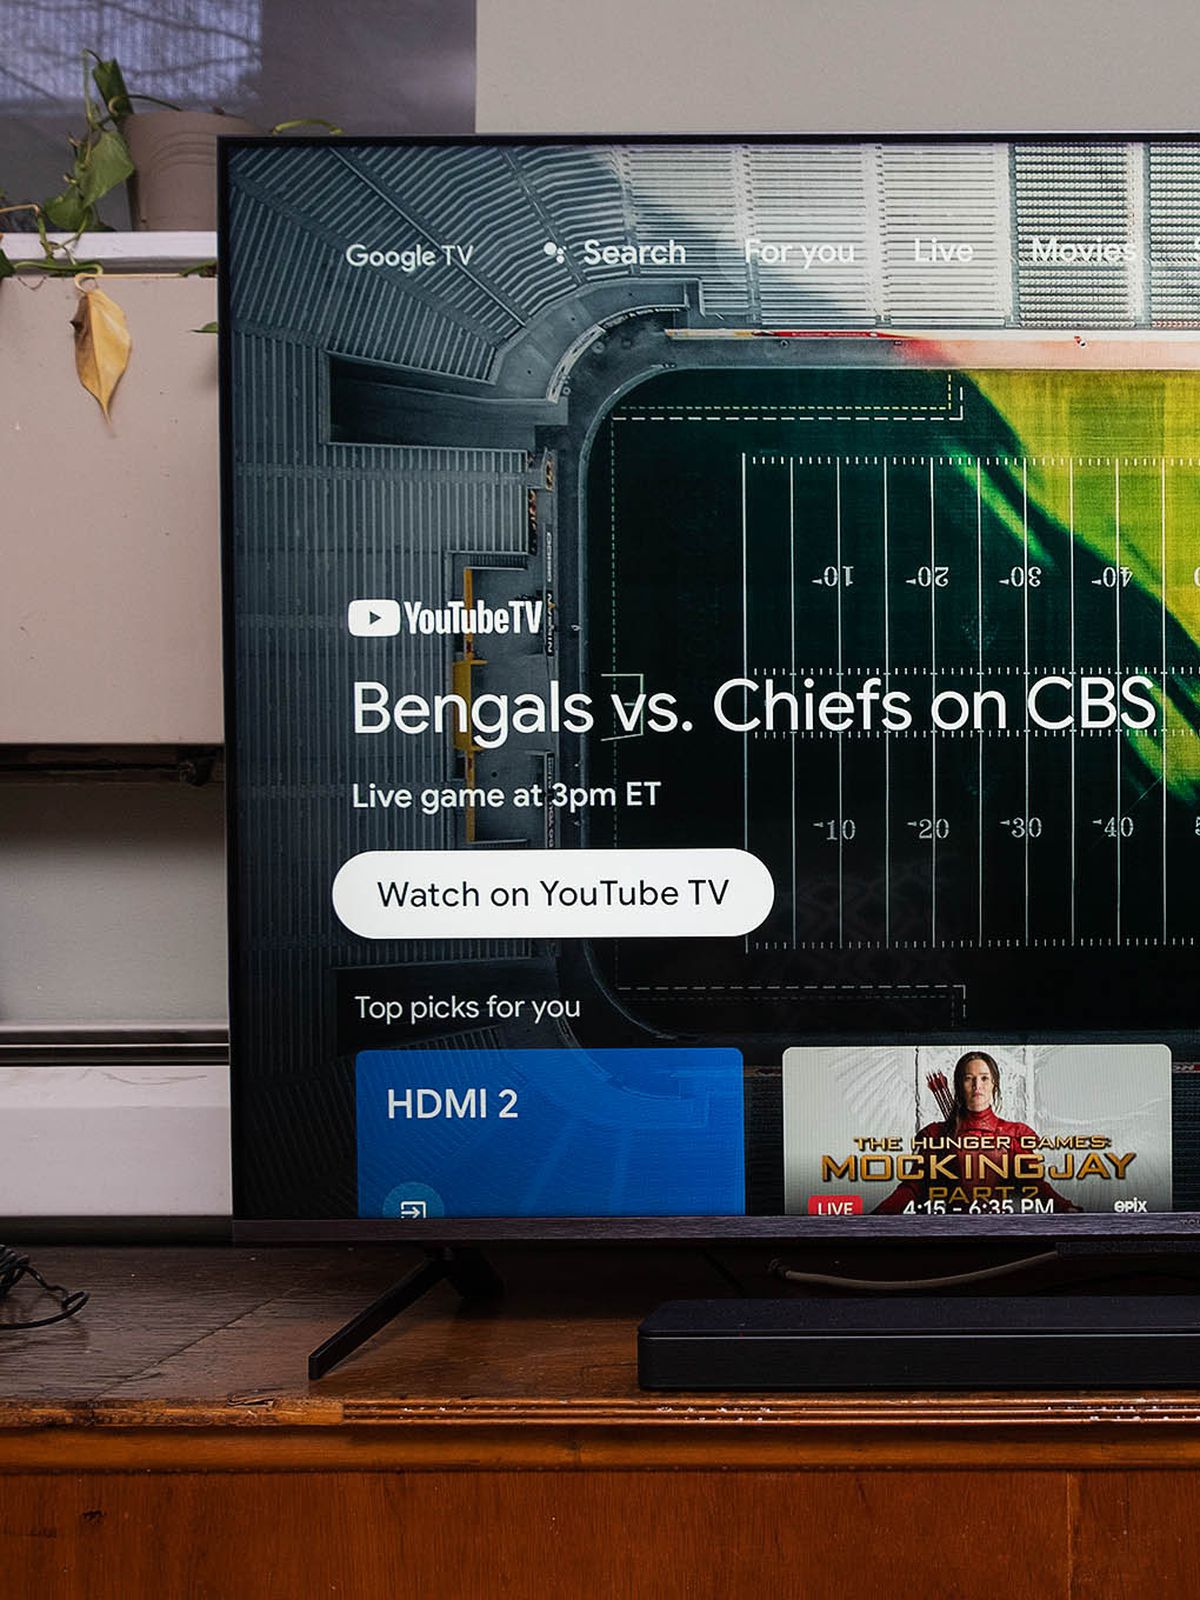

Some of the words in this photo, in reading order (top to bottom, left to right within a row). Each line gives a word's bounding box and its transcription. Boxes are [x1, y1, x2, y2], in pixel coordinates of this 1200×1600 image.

[346, 245, 435, 272] Google
[441, 246, 474, 267] TV
[583, 239, 686, 266] Search
[745, 239, 796, 265] For
[802, 244, 855, 270] you
[916, 237, 973, 263] Live
[1031, 236, 1137, 262] Movies
[823, 565, 855, 587] 10
[917, 565, 950, 587] 20
[1010, 565, 1042, 587] 30
[1103, 565, 1134, 587] 40
[353, 680, 594, 748] Bengals
[611, 692, 693, 733] vs.
[714, 677, 912, 732] Chiefs
[931, 690, 1007, 731] on
[1027, 675, 1157, 730] CBS
[352, 783, 412, 808] Live
[421, 788, 505, 814] game
[513, 783, 548, 808] at
[551, 783, 616, 812] 3pm
[626, 782, 662, 806] ET
[825, 819, 856, 841] 10
[918, 818, 950, 840] 20
[1011, 817, 1042, 838] 30
[1104, 816, 1134, 837] 40
[377, 881, 480, 907] Watch
[490, 886, 529, 907] on
[540, 880, 679, 906] YouTube
[688, 879, 729, 905] TV
[355, 995, 403, 1023] Top
[411, 995, 479, 1023] picks
[487, 995, 525, 1019] for
[532, 1000, 581, 1023] you
[387, 1088, 487, 1119] HDMI
[498, 1089, 519, 1119] 2
[854, 1137, 905, 1152] THE
[911, 1135, 1011, 1150] HUNGER
[821, 1152, 1137, 1182] MOCKINGJAY
[928, 1186, 1015, 1204] PART
[1020, 1198, 1055, 1214] PM
[1114, 1196, 1148, 1213] epix
[818, 1202, 853, 1215] LIVE
